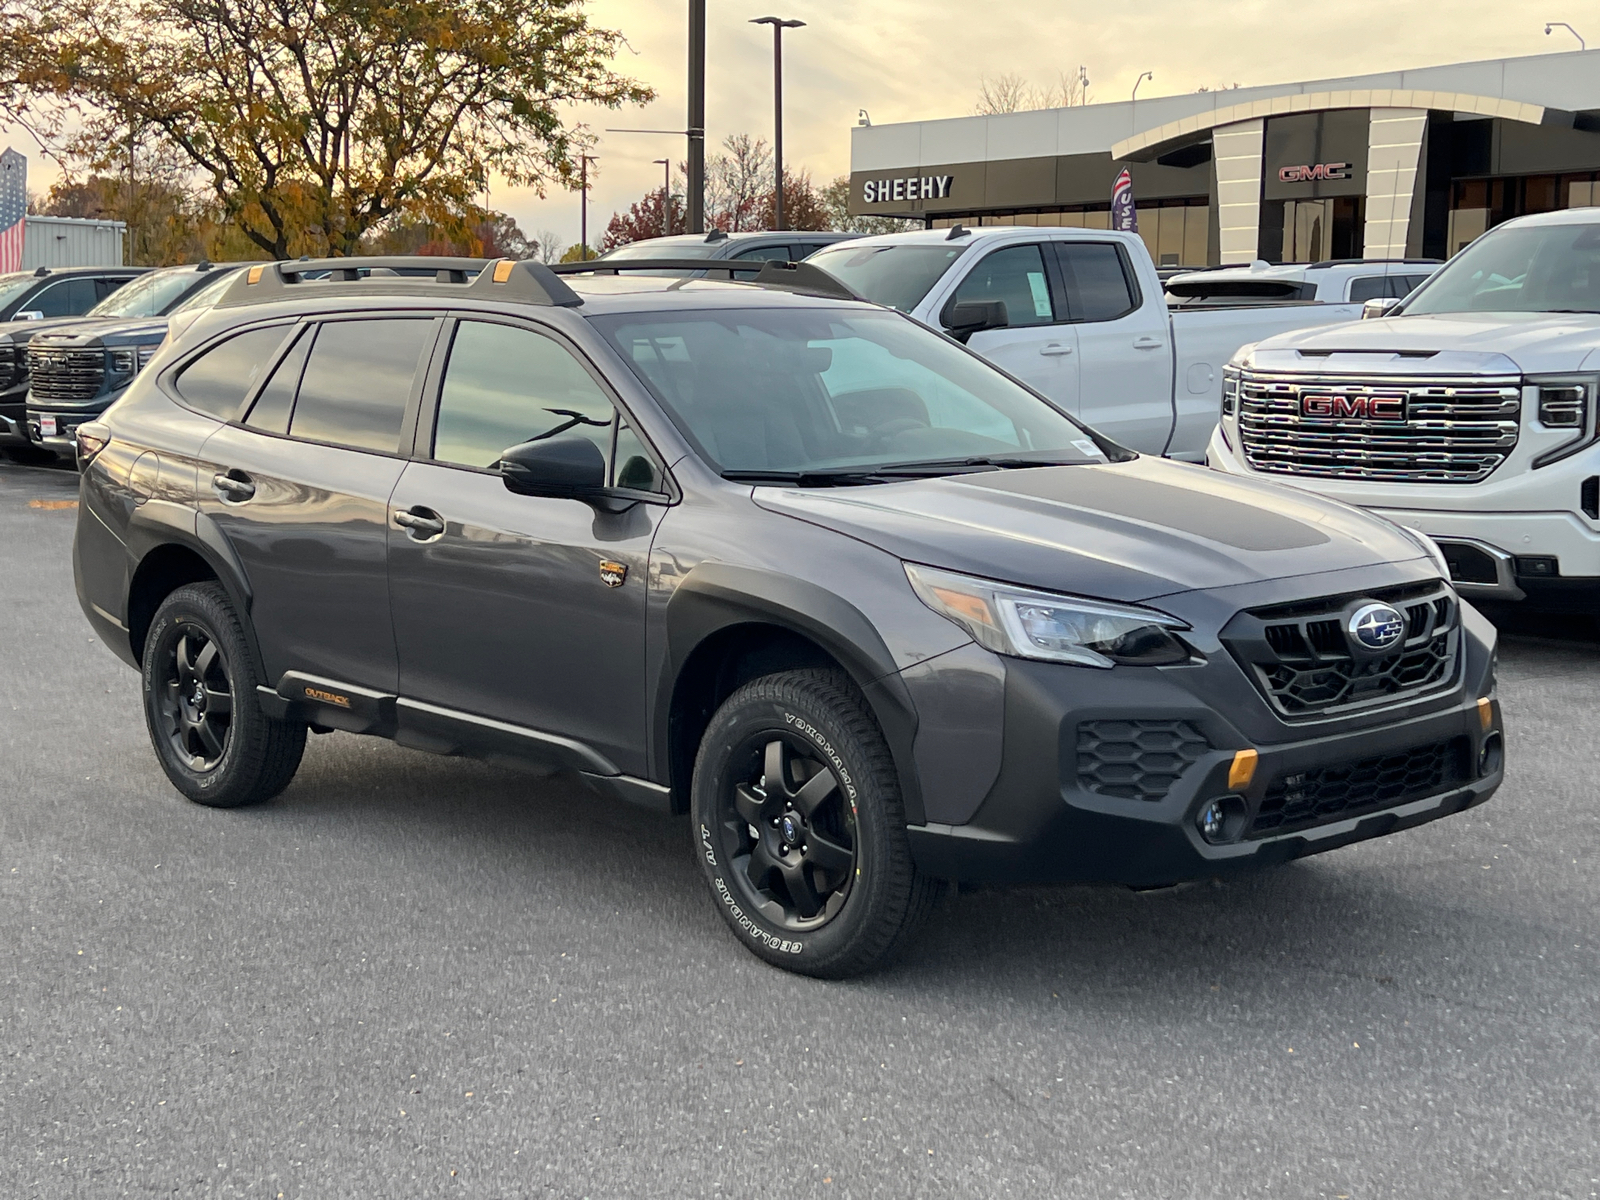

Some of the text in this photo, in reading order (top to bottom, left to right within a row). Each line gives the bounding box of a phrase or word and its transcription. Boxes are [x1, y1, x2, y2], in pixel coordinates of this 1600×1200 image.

[1279, 162, 1347, 182] GMC
[863, 175, 949, 203] SHEEHY
[1303, 395, 1402, 419] GMC
[784, 712, 857, 799] YOKOHAMA
[700, 823, 803, 954] GEOLANDAR A/T
